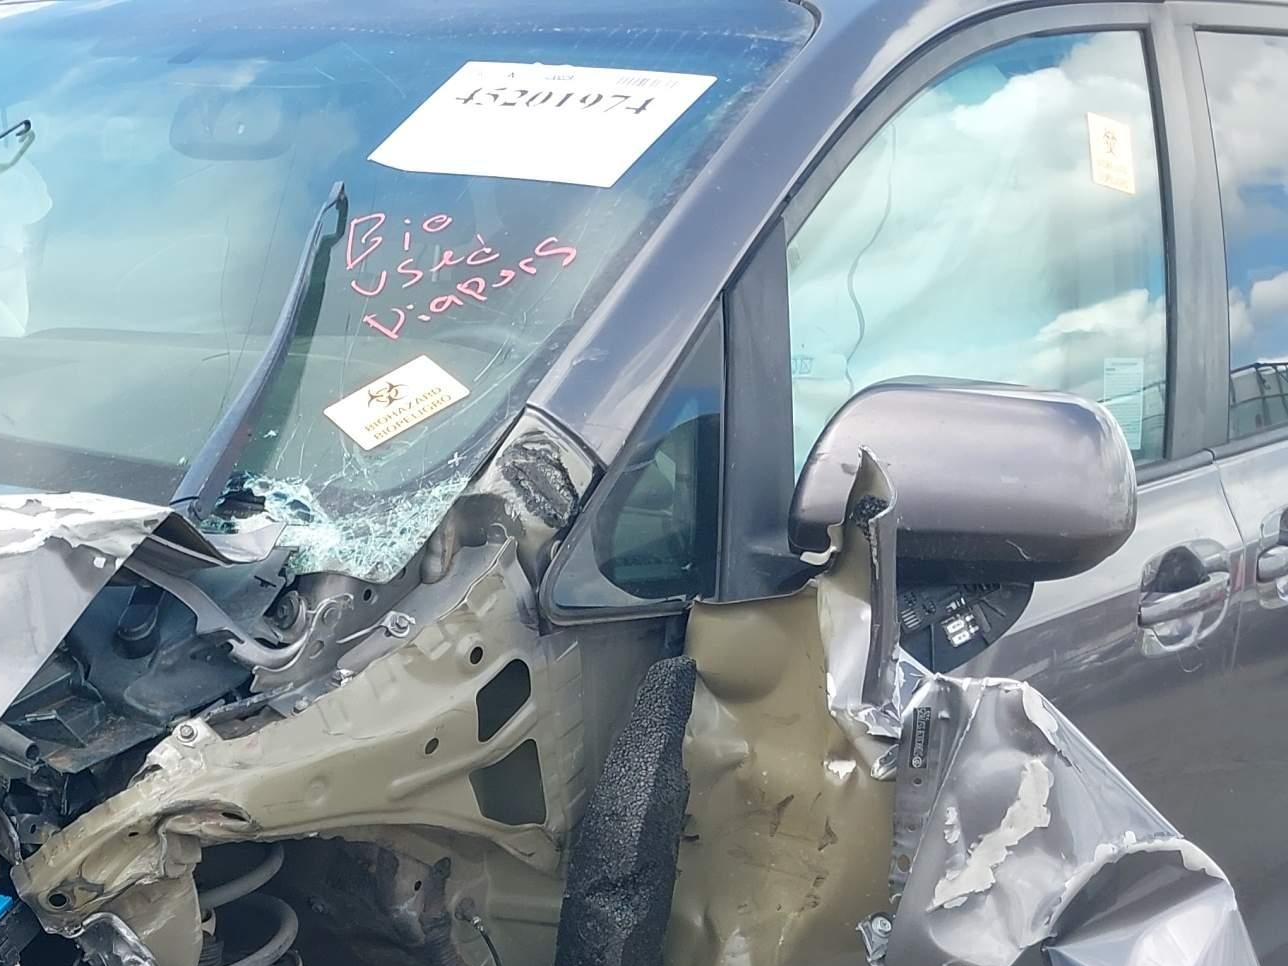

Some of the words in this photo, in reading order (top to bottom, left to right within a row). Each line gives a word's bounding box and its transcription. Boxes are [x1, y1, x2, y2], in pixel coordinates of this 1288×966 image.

[455, 87, 656, 115] 45201974
[346, 213, 452, 270] Bio
[364, 386, 442, 433] BIOHAZARD
